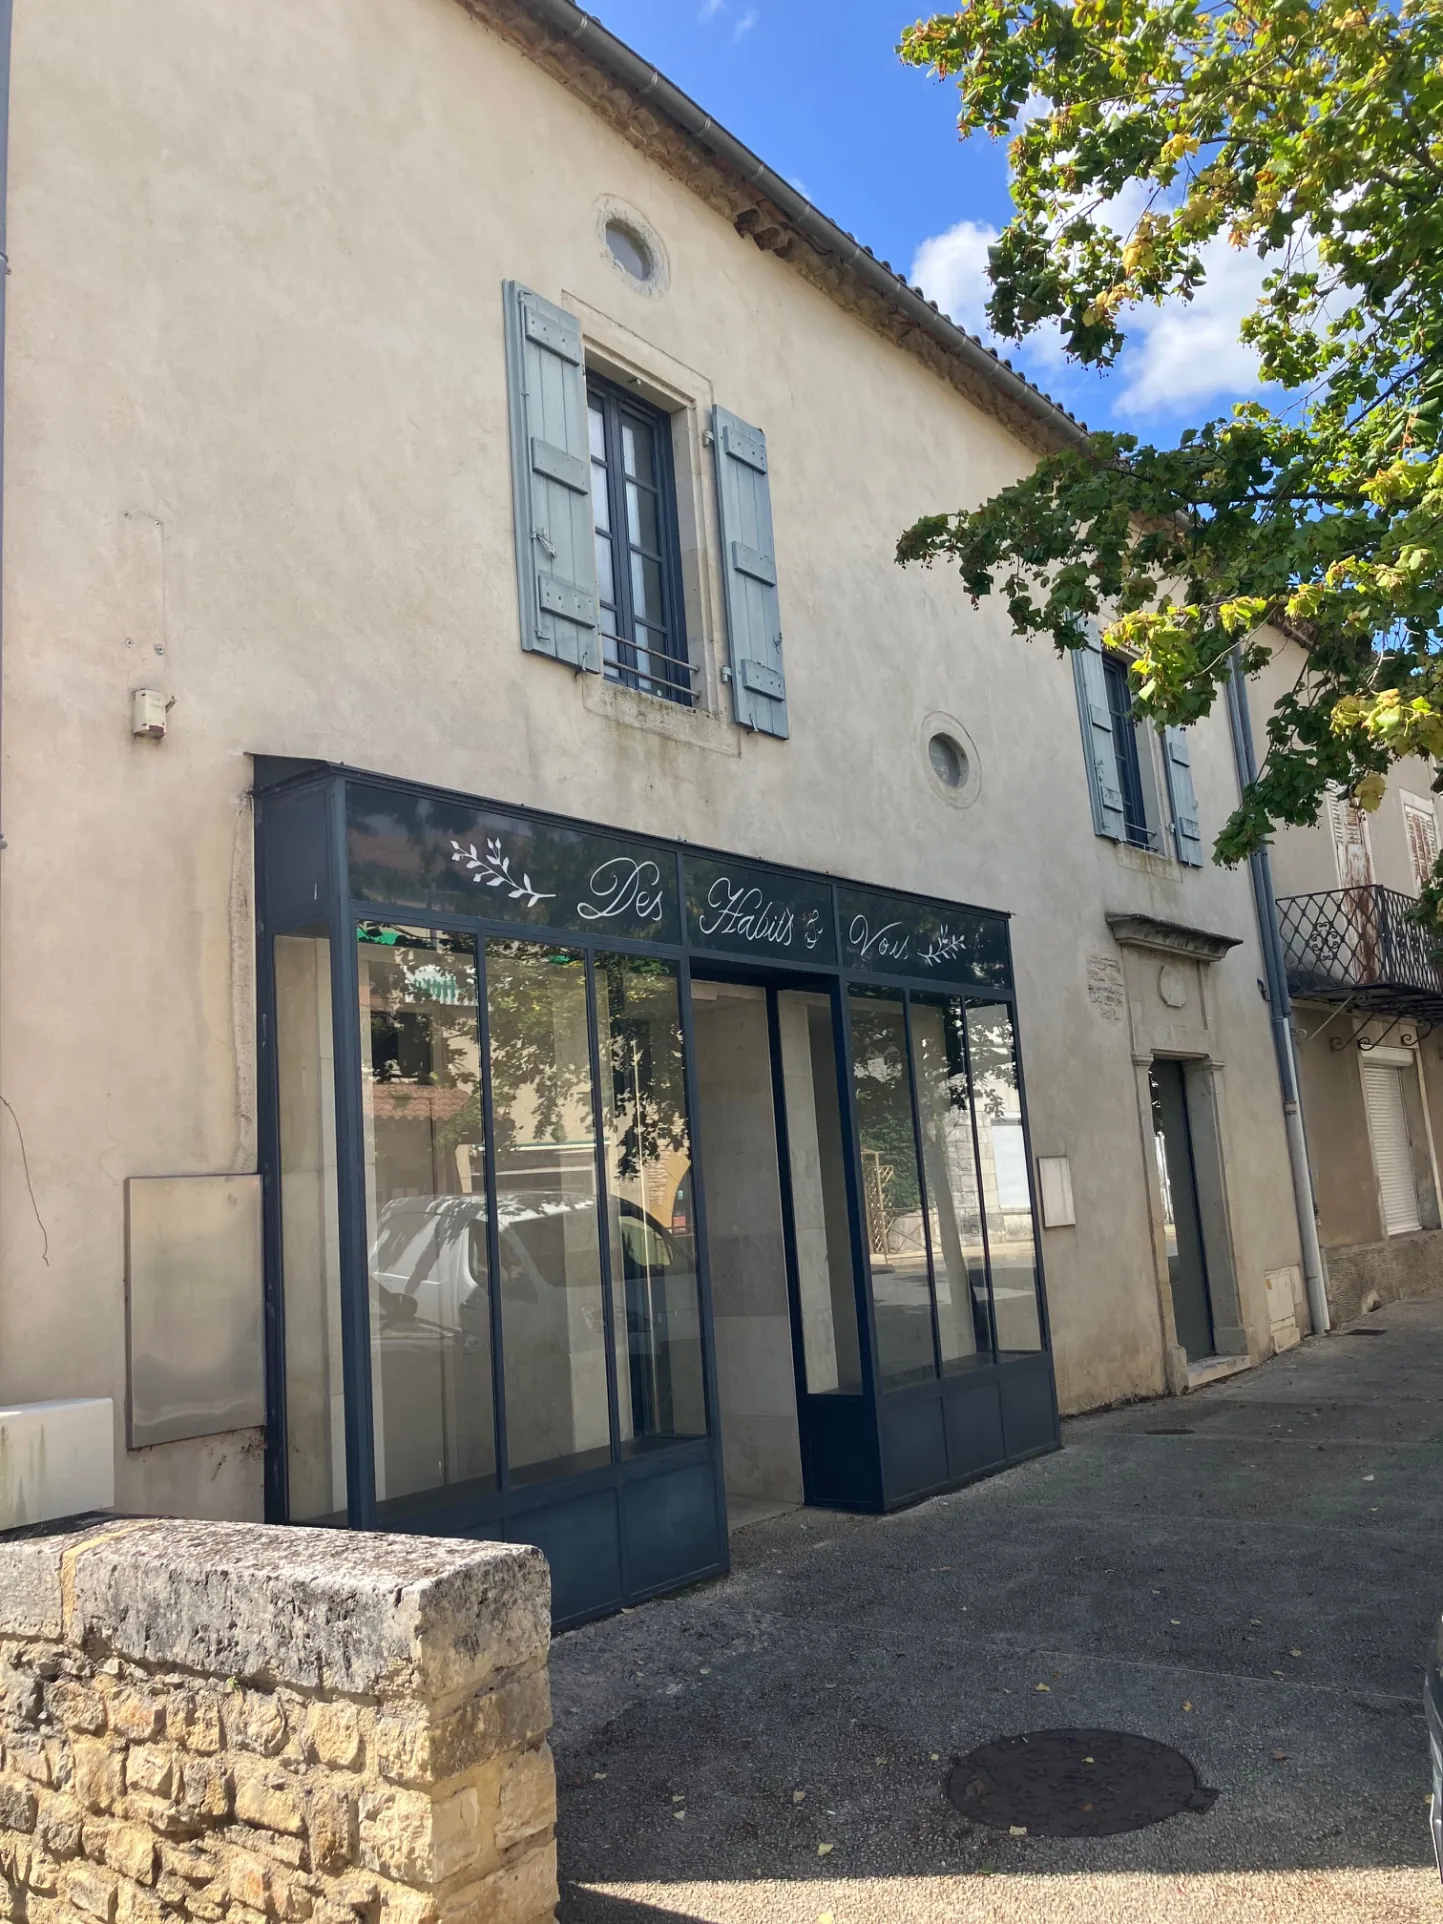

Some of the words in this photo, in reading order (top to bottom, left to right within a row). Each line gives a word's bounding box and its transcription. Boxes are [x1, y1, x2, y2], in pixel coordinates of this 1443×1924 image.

[577, 857, 664, 920] Des
[699, 877, 795, 946] Habits
[850, 914, 910, 960] Vous
